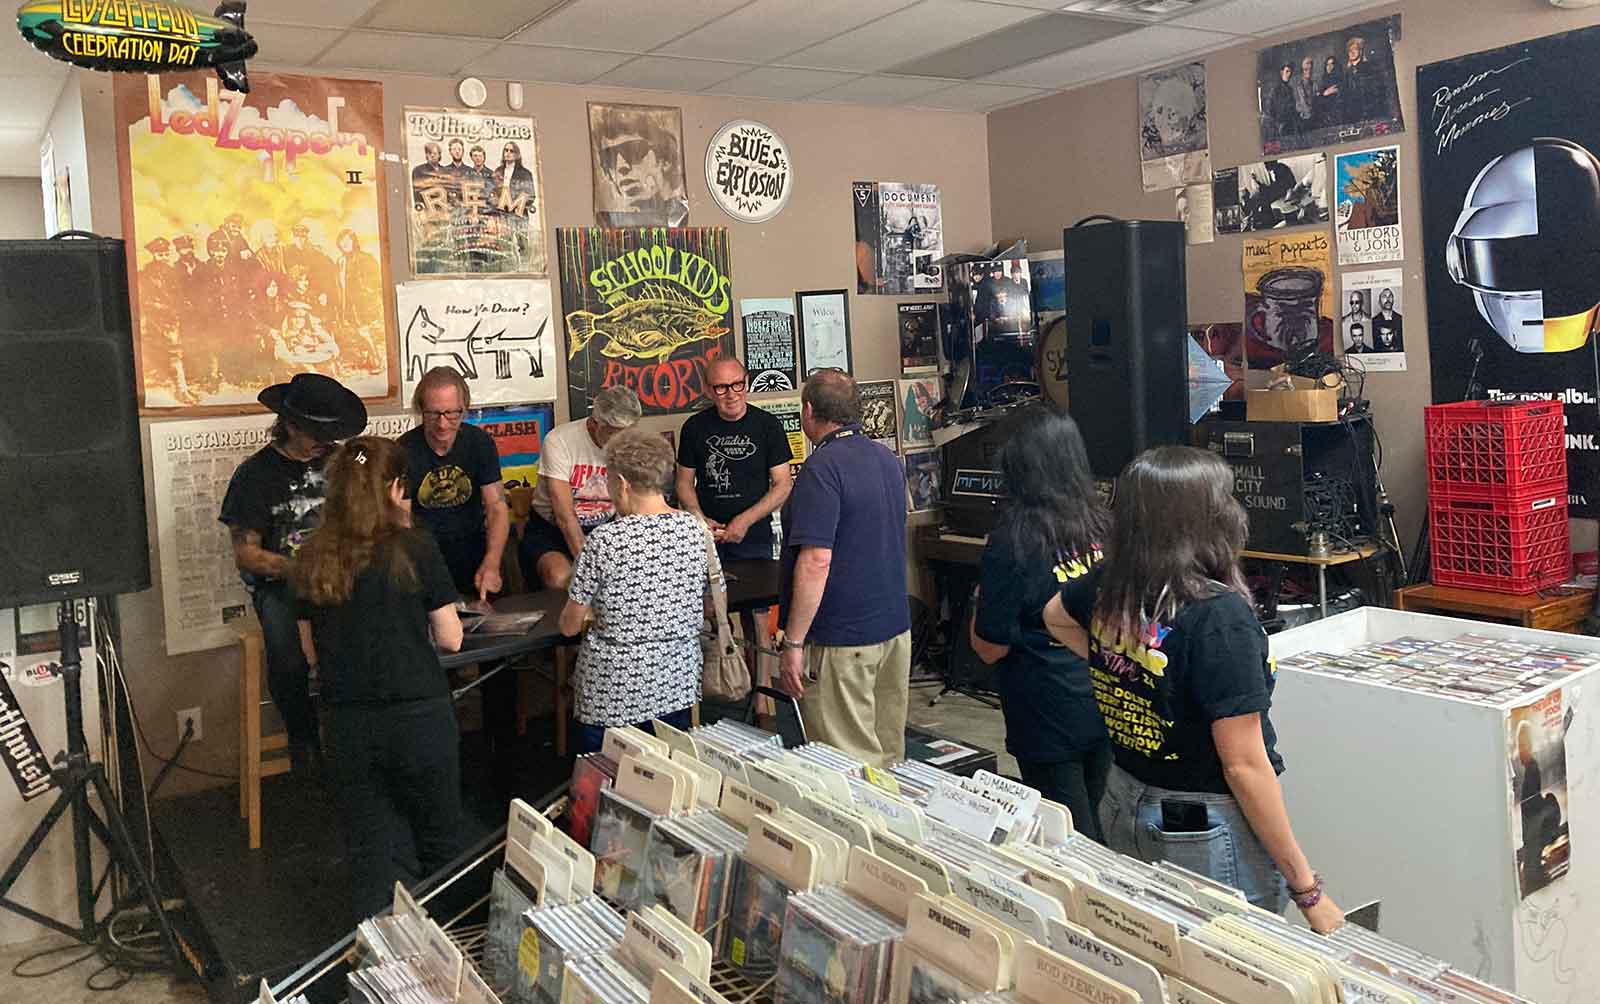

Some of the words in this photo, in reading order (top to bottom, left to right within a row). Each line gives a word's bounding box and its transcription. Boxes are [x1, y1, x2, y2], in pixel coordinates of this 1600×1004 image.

[62, 32, 162, 63] CELEBRATION
[167, 43, 199, 65] DAY
[1431, 57, 1532, 118] Random
[1435, 88, 1502, 135] Access
[409, 115, 482, 143] Rolling
[482, 118, 531, 140] Stone
[1437, 97, 1532, 155] Memories
[728, 132, 782, 169] BLUES
[346, 170, 363, 185] II
[716, 161, 786, 200] EXPLOSION
[884, 192, 936, 203] DOCUMENT
[1338, 226, 1400, 244] MUMFORD
[1353, 242, 1362, 252] &
[1366, 237, 1399, 251] SONS
[1245, 240, 1278, 257] meat
[1280, 235, 1328, 258] puppets
[229, 428, 271, 447] STOR
[484, 420, 537, 438] CLASH
[712, 435, 751, 446] Nudie's
[1236, 480, 1262, 494] CITY
[1245, 495, 1286, 511] SOUND
